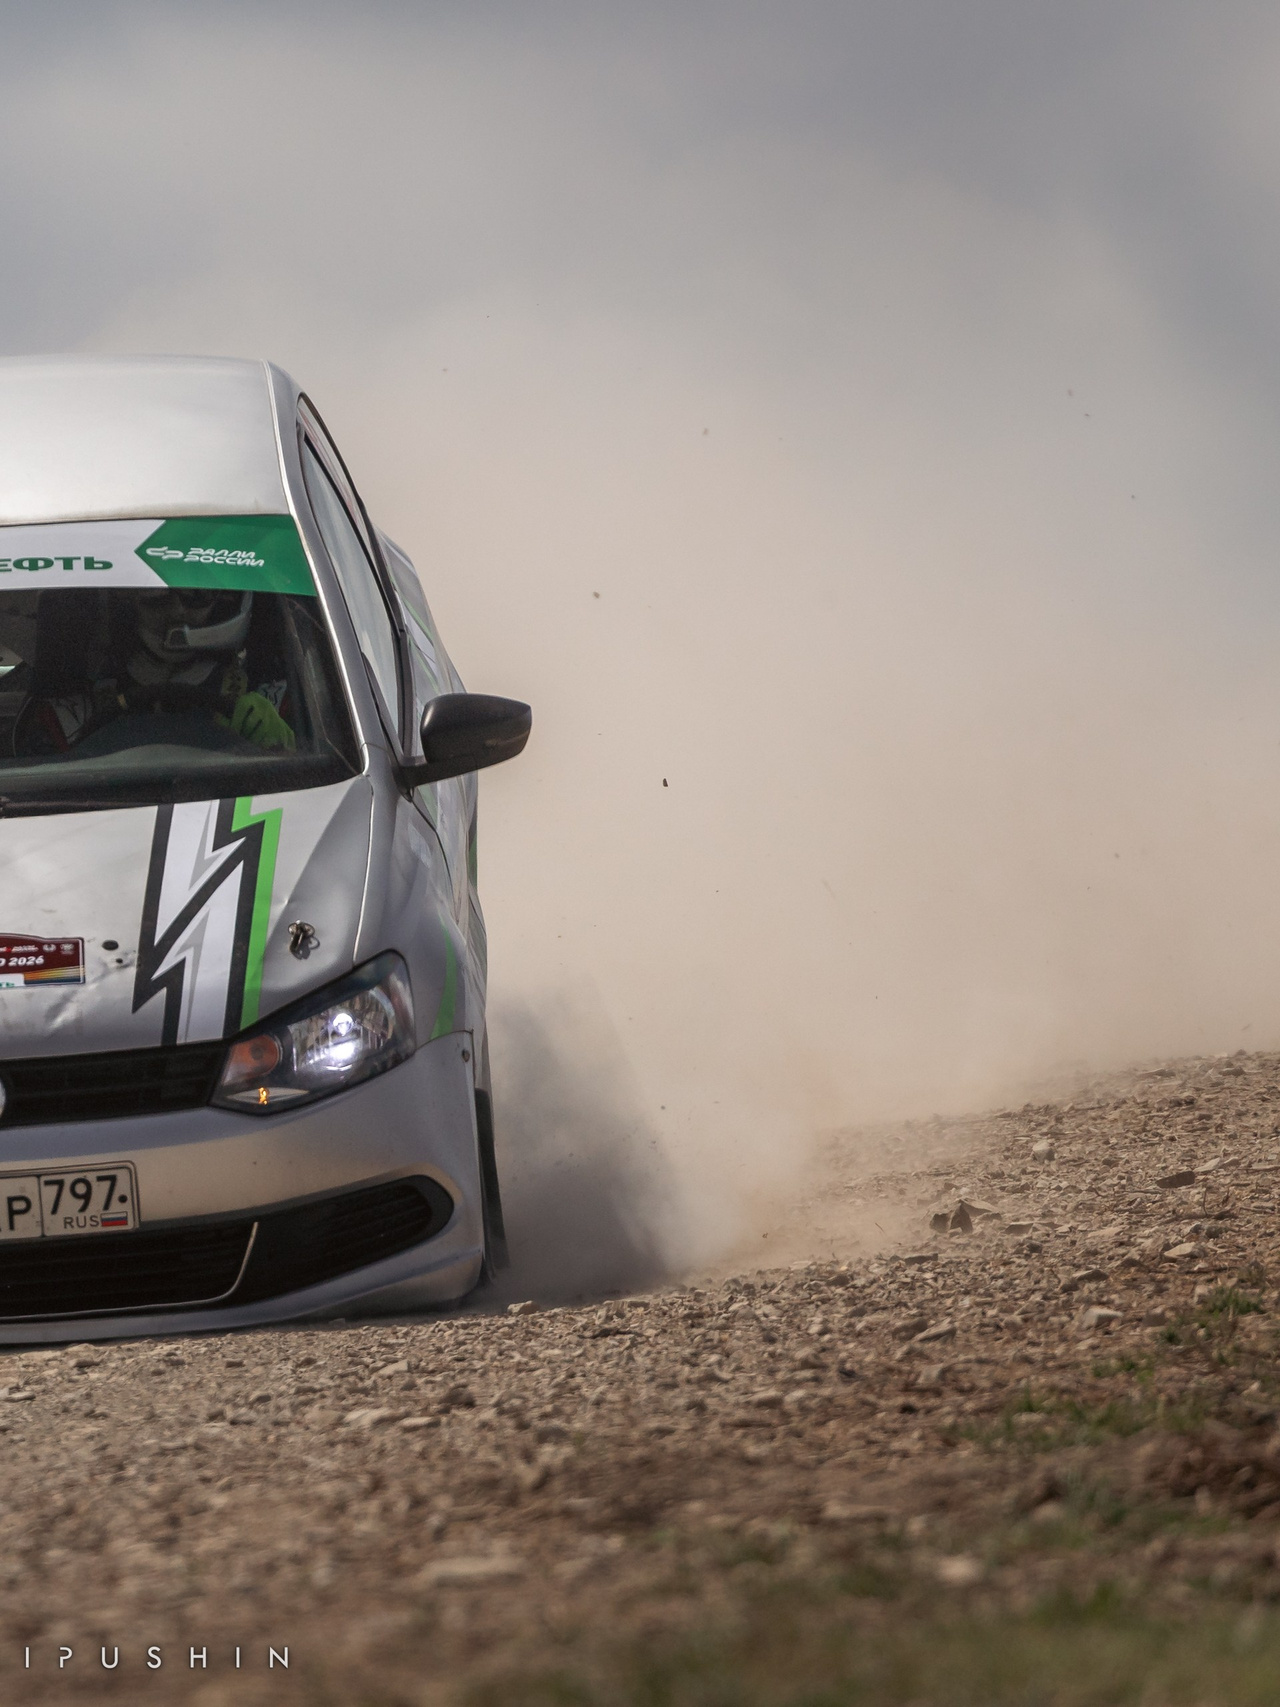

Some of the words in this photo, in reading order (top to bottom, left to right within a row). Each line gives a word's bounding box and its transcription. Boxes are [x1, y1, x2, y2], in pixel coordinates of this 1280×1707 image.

[187, 547, 256, 559] РАЛЛИ
[183, 555, 265, 567] РОССИИ
[9, 955, 44, 966] 2026
[43, 1175, 118, 1216] 797
[63, 1213, 99, 1229] RUS
